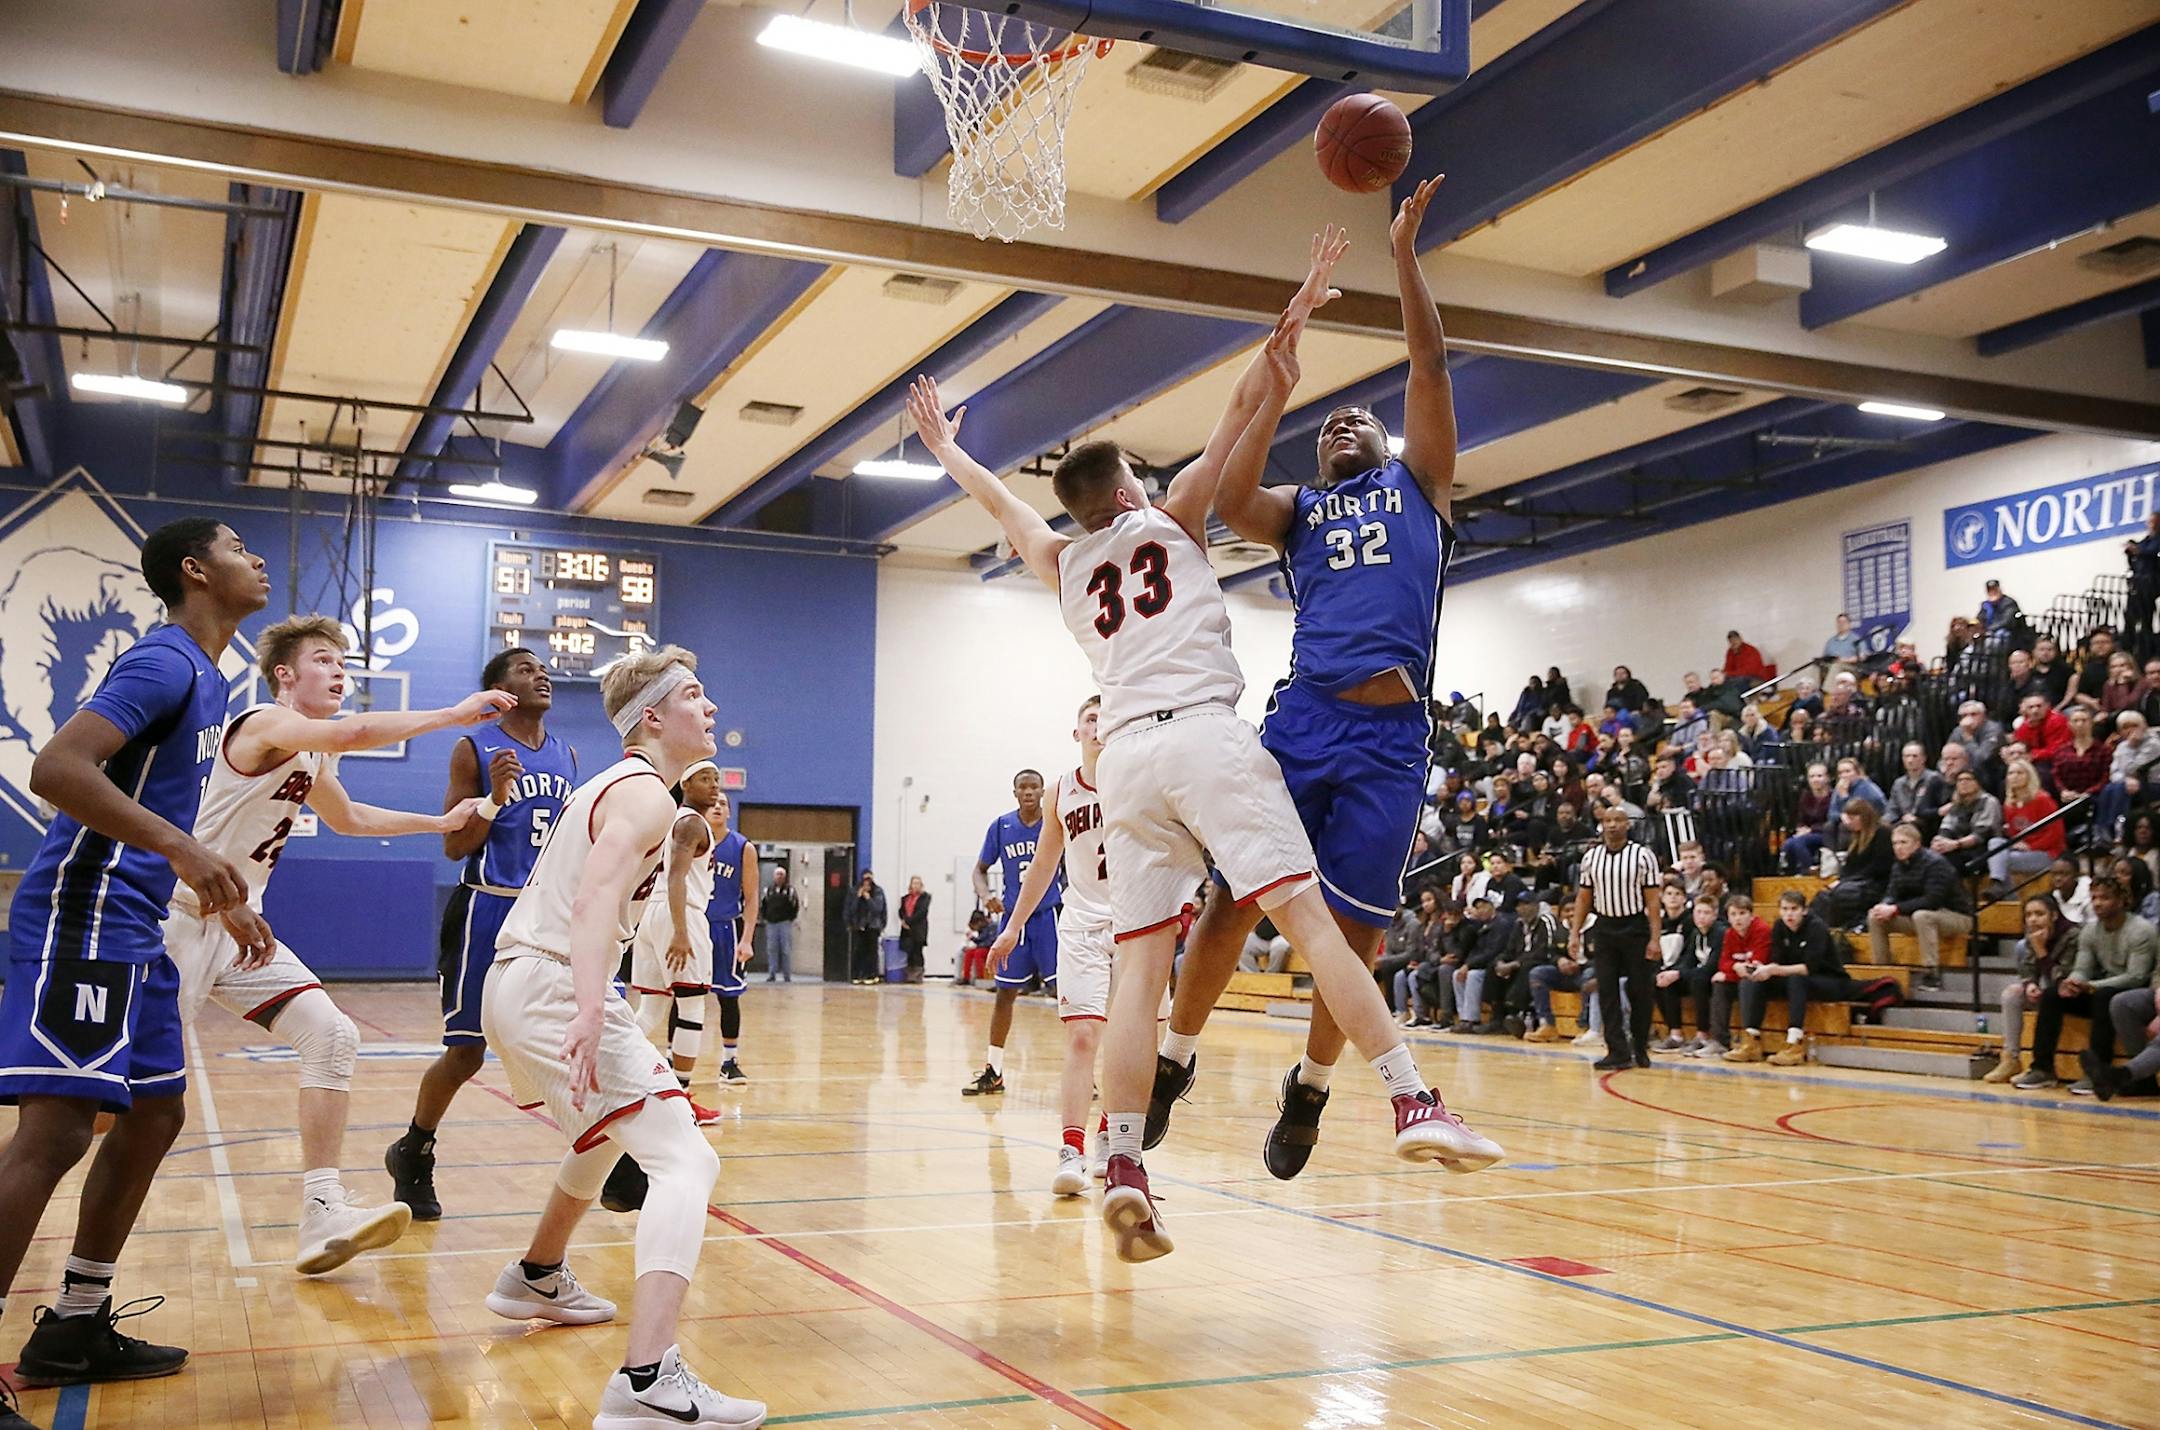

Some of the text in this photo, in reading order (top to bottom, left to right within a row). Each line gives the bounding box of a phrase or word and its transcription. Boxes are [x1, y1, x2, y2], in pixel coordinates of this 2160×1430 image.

[1306, 487, 1402, 531] NORTH
[1991, 472, 2160, 551] NORTH
[1325, 521, 1391, 571] 32
[497, 567, 531, 595] 51
[621, 576, 654, 604] 58
[1086, 540, 1173, 640] 33
[249, 816, 293, 869] 2
[531, 808, 551, 847] 5
[74, 983, 107, 1023] N
